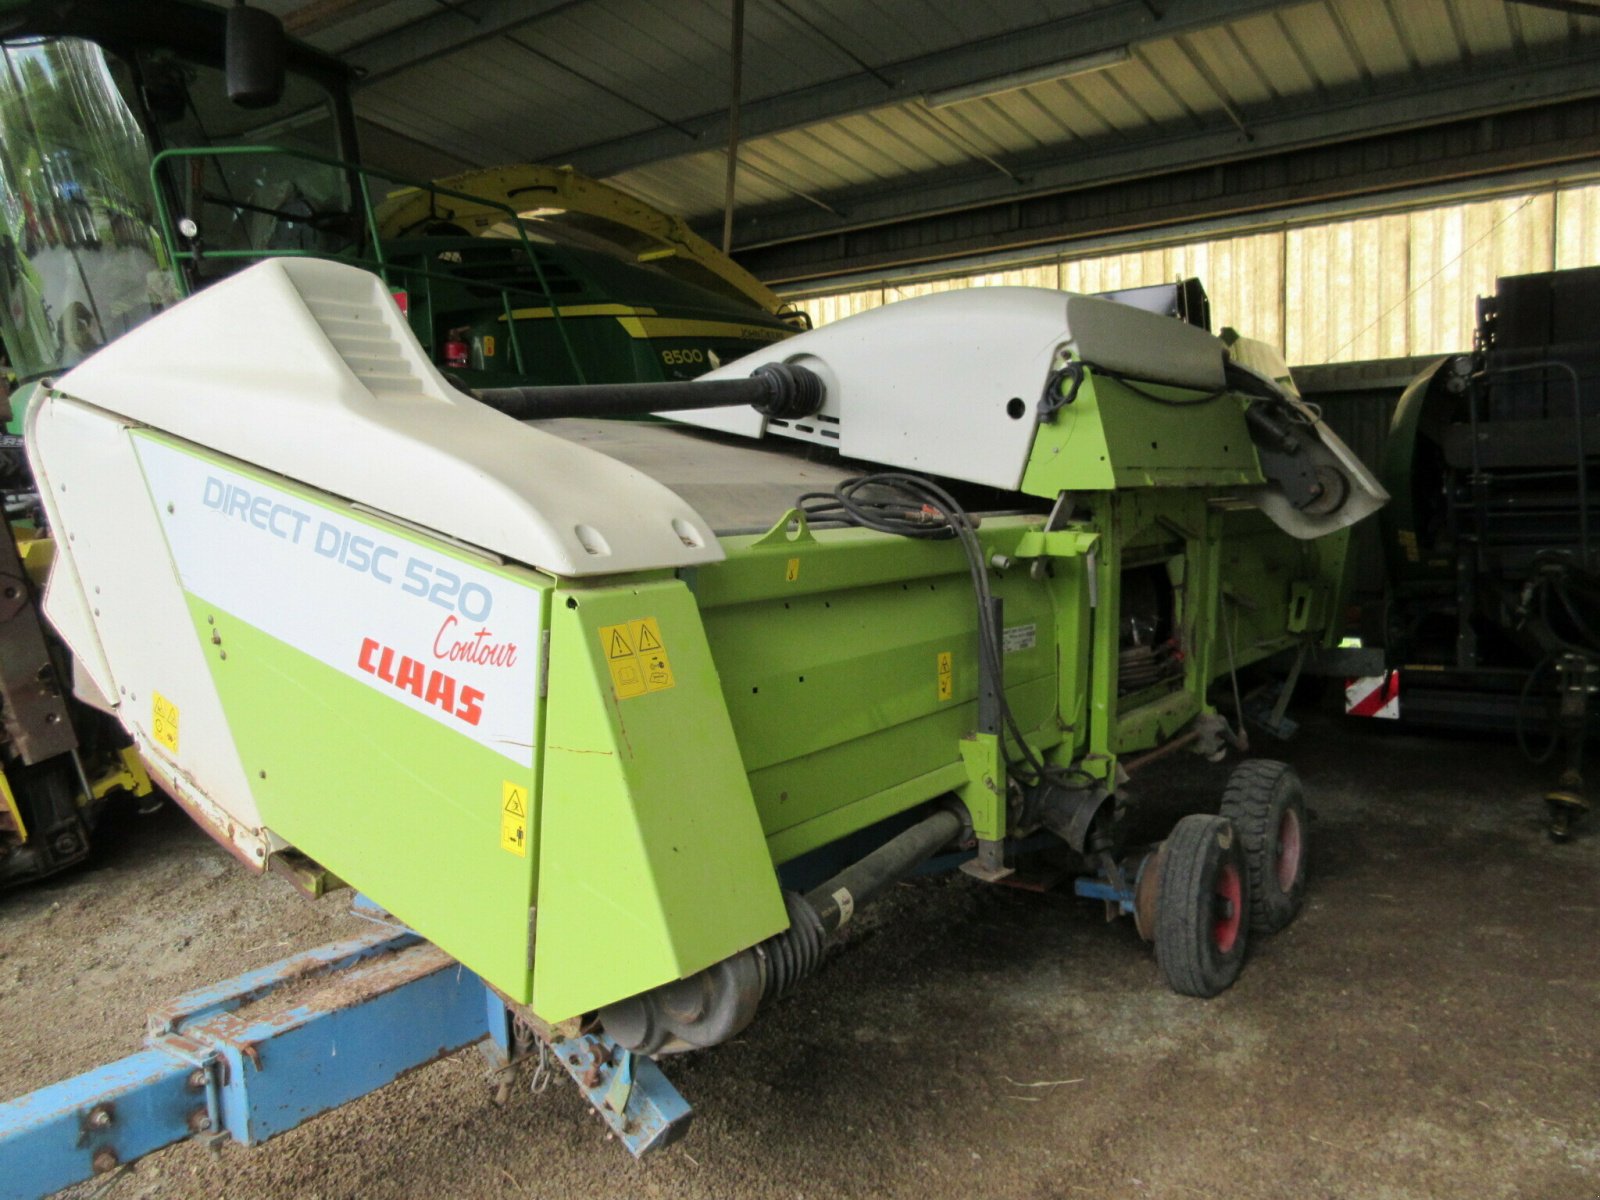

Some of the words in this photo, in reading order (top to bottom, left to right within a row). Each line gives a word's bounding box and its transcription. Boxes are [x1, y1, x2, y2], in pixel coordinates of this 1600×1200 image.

[662, 349, 704, 365] 8500
[202, 476, 311, 544] DIRECT
[314, 521, 399, 585] DISC
[401, 557, 493, 623] 520
[433, 614, 517, 667] Contour
[357, 637, 486, 726] CLAAS
